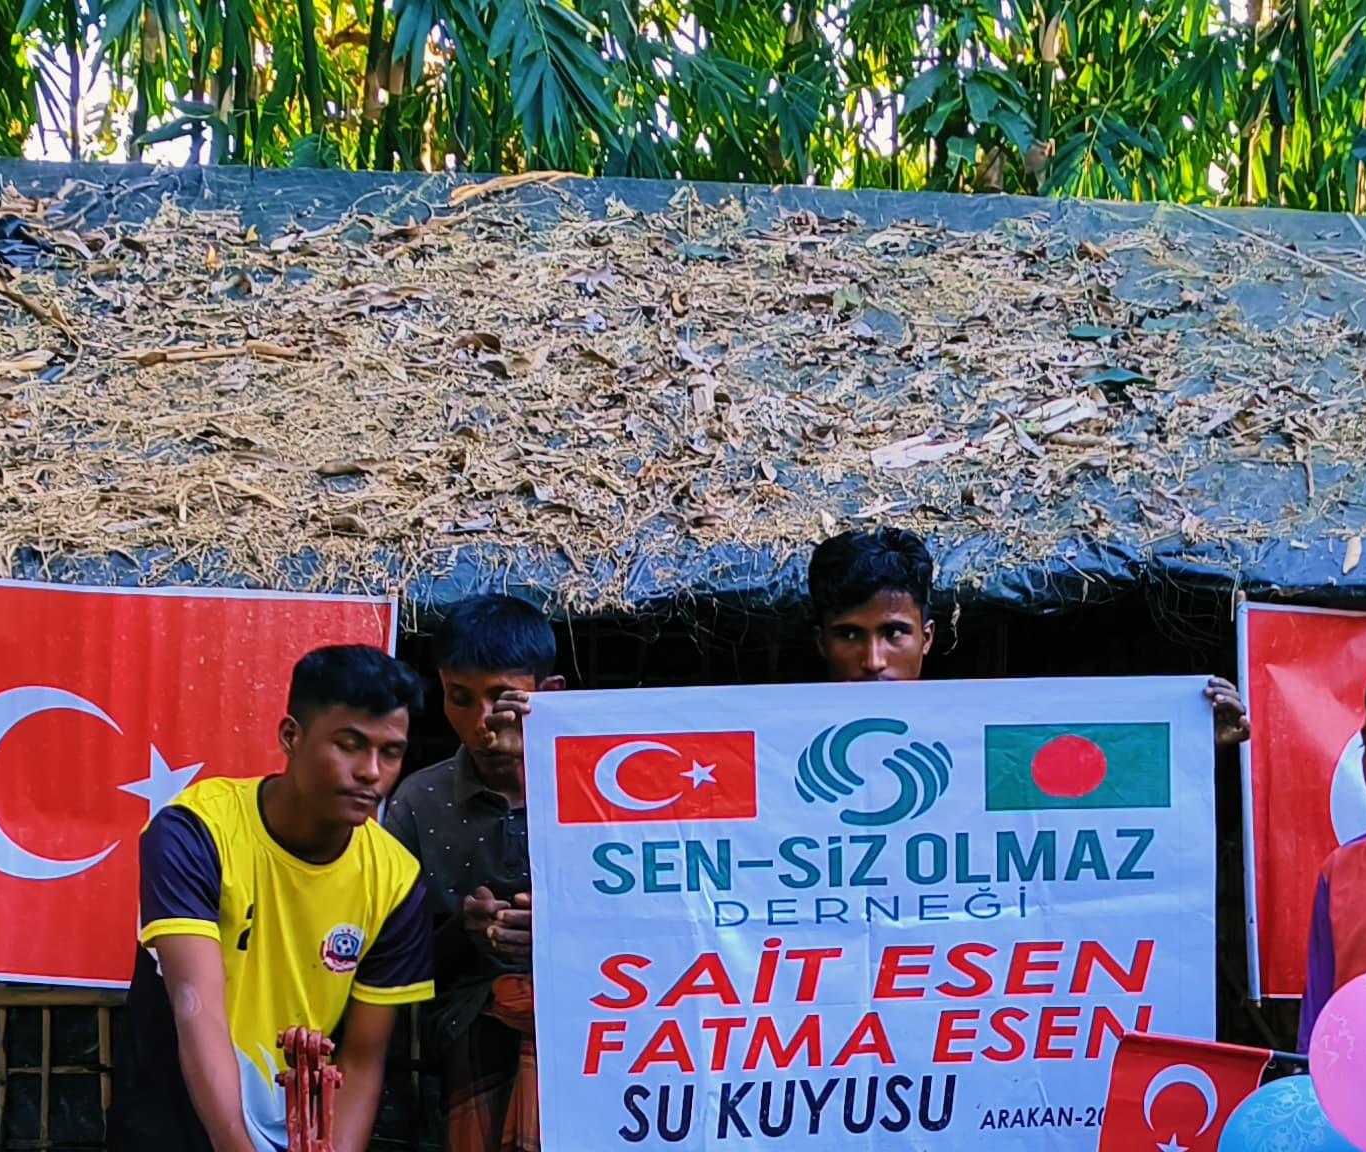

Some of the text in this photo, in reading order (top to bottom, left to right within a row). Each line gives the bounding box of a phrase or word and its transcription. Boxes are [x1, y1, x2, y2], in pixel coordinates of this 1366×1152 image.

[905, 828, 1155, 886] OLMAZ
[713, 885, 1029, 928] DERNEĞİ
[589, 937, 1154, 1010] SAİT ESEN
[582, 1006, 1151, 1075] FATMA ESEN
[619, 1084, 694, 1143] SU
[717, 1075, 957, 1140] KUYUSU
